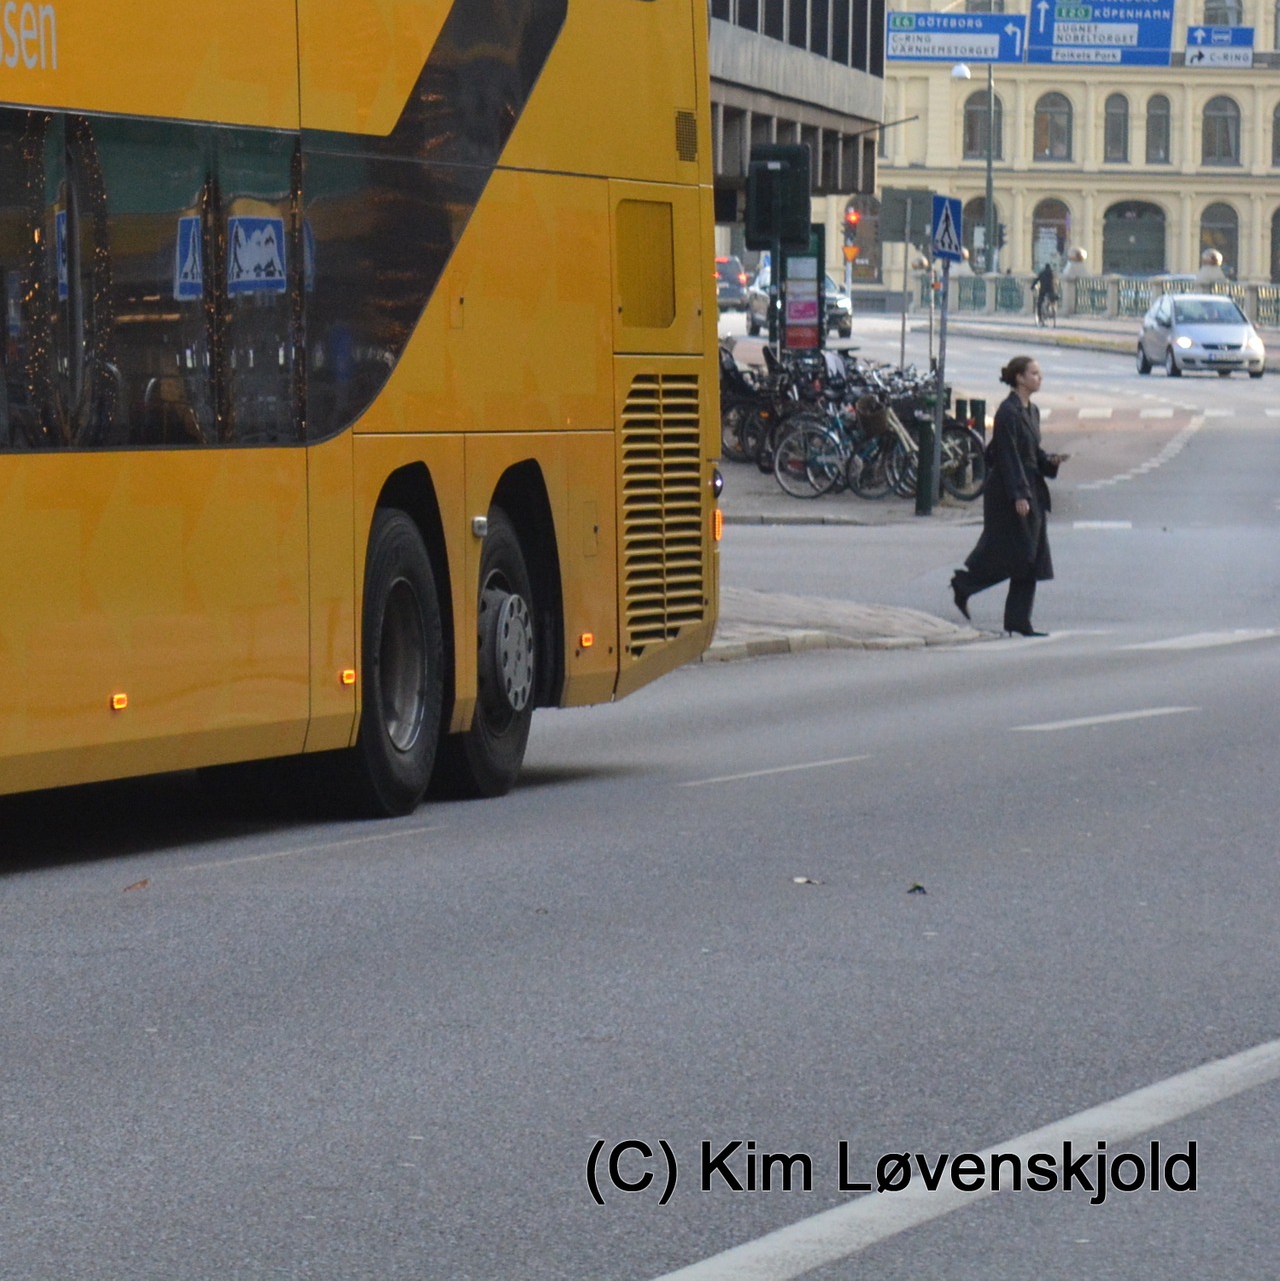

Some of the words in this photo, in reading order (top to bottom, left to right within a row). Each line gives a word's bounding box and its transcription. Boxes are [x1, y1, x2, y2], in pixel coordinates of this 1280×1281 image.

[1059, 6, 1086, 17] E20
[1093, 6, 1171, 20] KÖPENHAMN
[893, 16, 913, 28] E6
[918, 16, 983, 29] GÖTEBORG
[1056, 24, 1099, 33] LUGNET
[892, 34, 932, 43] C-RING
[1056, 33, 1135, 44] NOBELTORGET
[891, 44, 996, 57] VÄRNHEMSTORGET
[1055, 49, 1092, 60] Folkets
[1095, 49, 1117, 60] Park
[1209, 54, 1249, 63] C-RING
